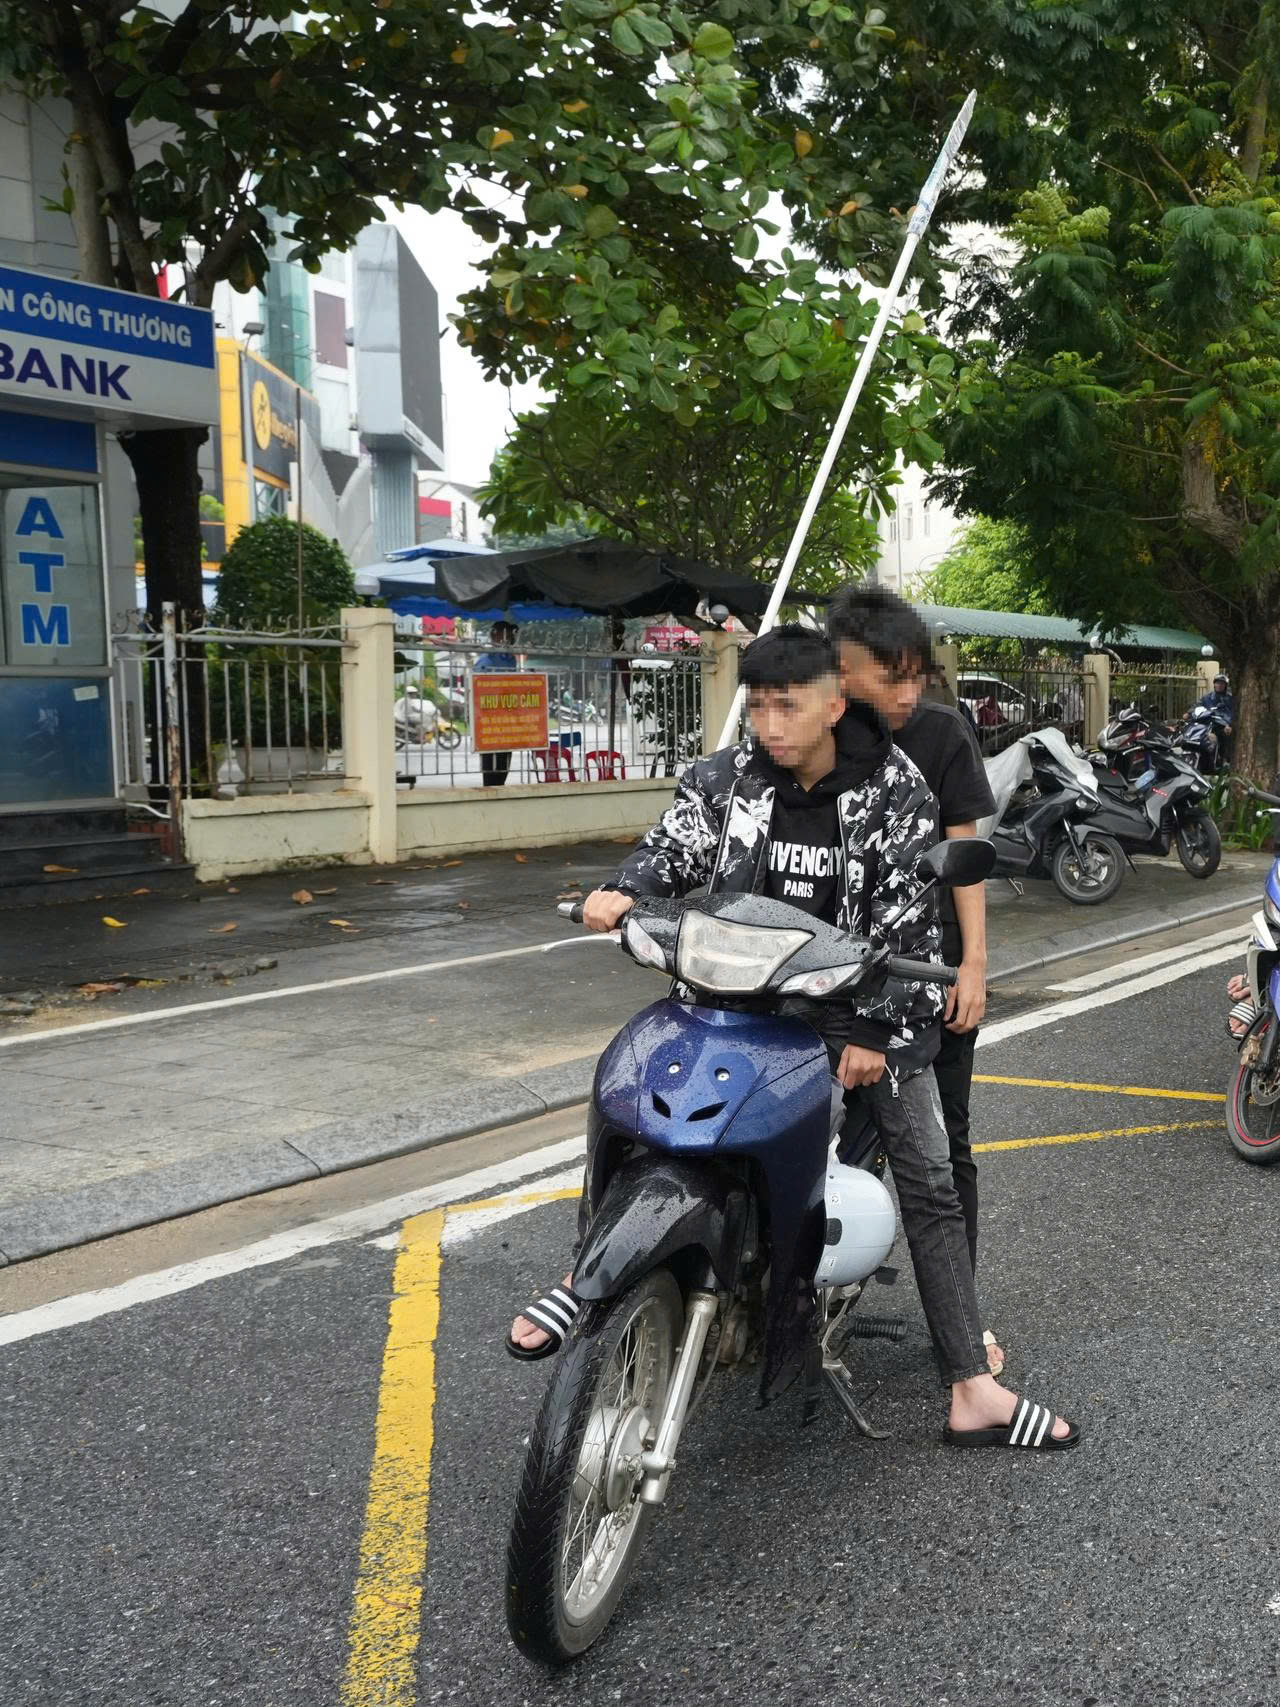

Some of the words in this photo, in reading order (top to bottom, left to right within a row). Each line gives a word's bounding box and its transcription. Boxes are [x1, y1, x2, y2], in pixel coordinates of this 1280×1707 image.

[22, 292, 92, 328] CÔNG
[99, 308, 192, 348] THƯƠNG
[15, 496, 71, 646] ATM
[480, 695, 498, 709] KHU
[783, 879, 814, 898] PARIS
